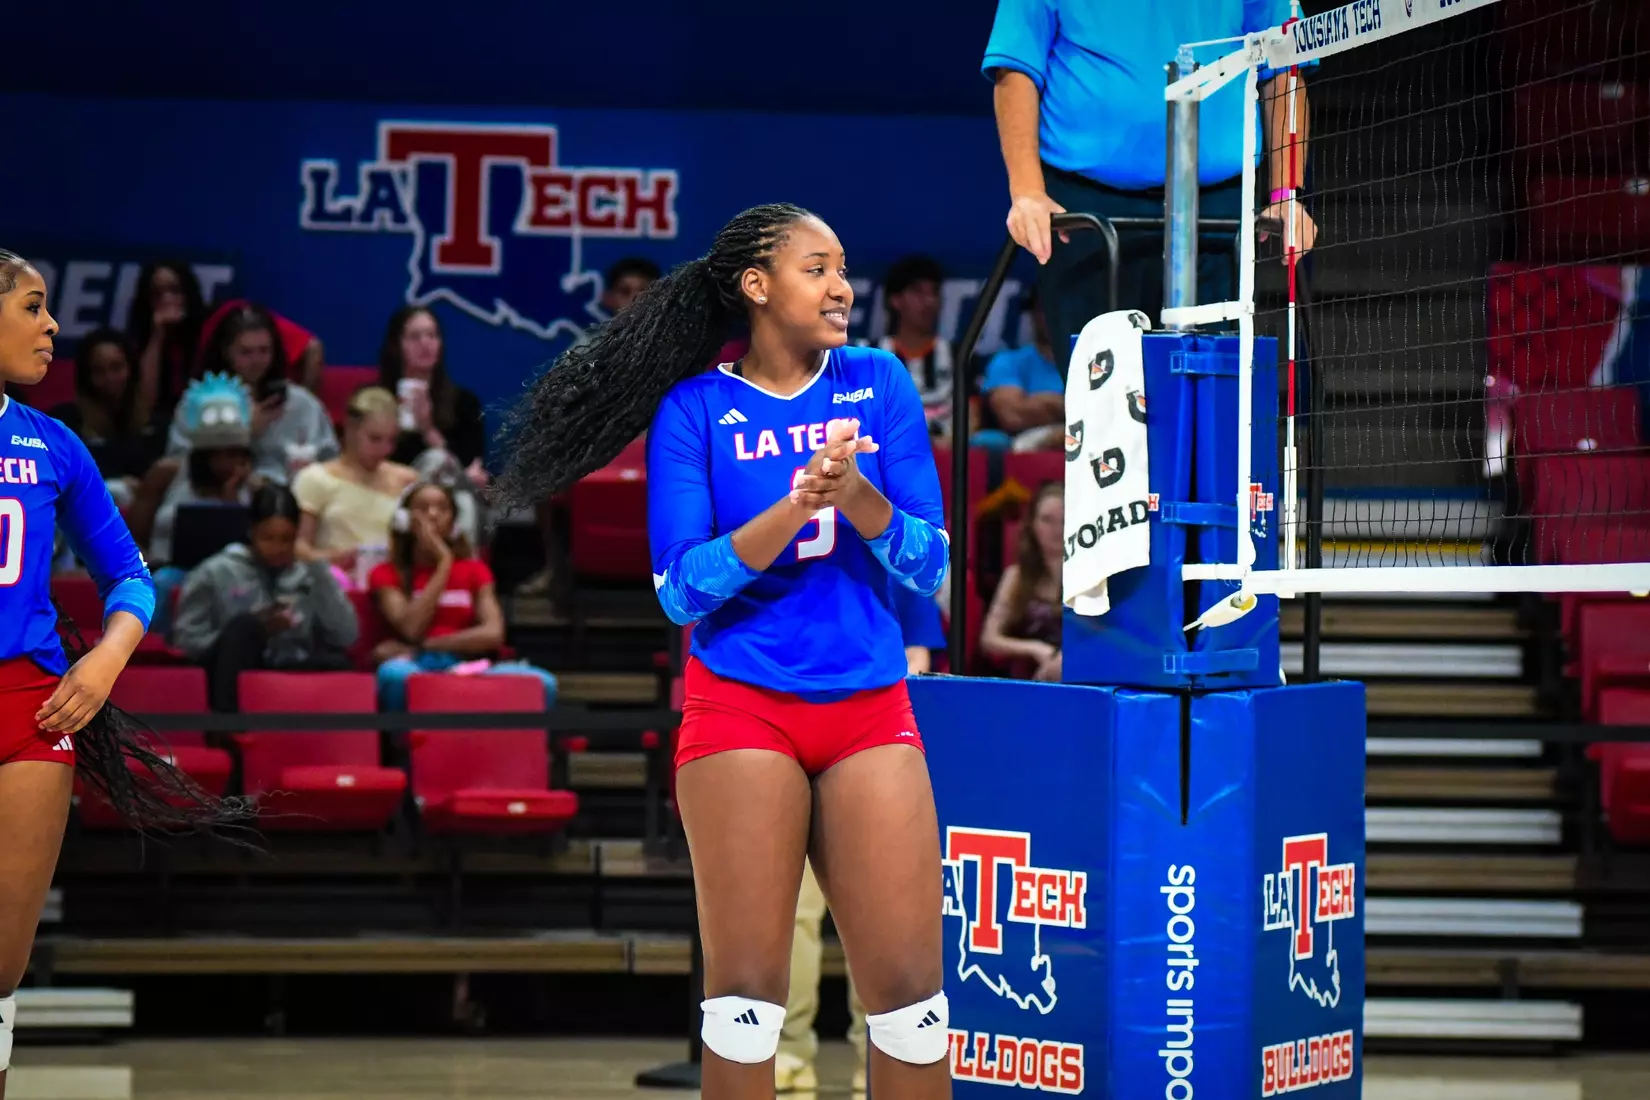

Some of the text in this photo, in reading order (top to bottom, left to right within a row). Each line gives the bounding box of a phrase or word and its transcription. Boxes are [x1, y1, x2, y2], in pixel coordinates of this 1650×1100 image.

[1352, 0, 1382, 36] TECH
[301, 121, 678, 275] LA TECH
[735, 417, 860, 460] LA TE
[946, 825, 1087, 955] TECH
[1159, 864, 1199, 991] sports
[1263, 832, 1355, 961] LA TECH
[947, 1028, 1085, 1095] LLDOGS
[1262, 1029, 1353, 1098] BULLDOGS
